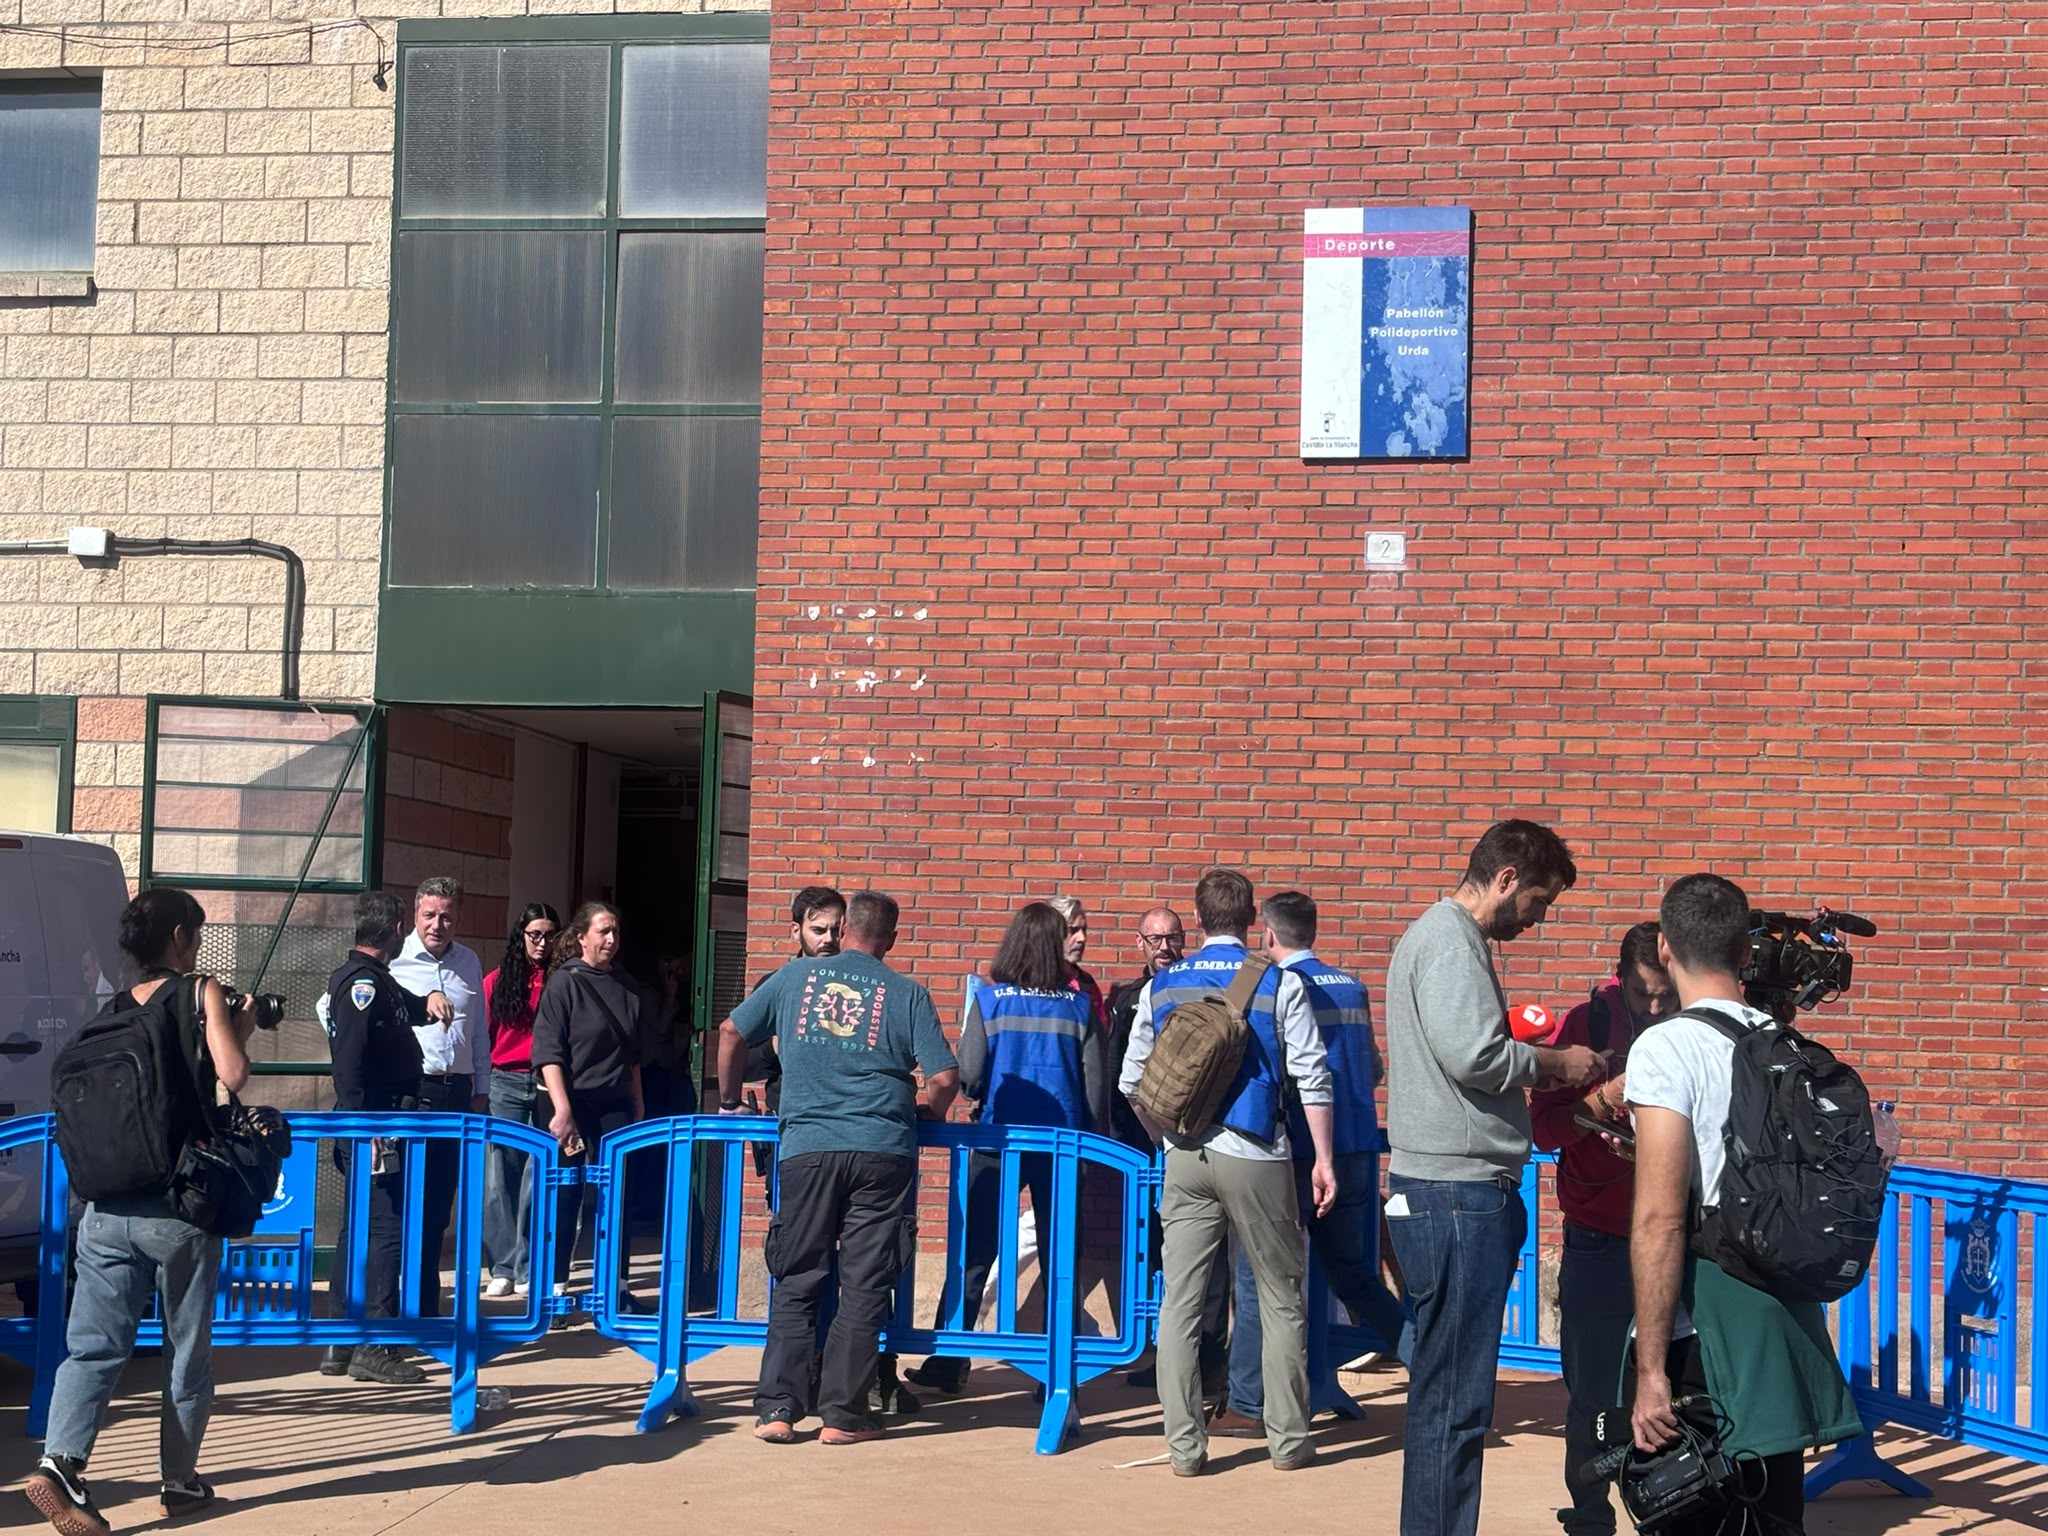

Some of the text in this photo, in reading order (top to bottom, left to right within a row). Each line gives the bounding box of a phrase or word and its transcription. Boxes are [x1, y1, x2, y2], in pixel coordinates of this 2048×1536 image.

[1325, 238, 1395, 253] Deporte
[1386, 307, 1444, 318] Pabellón
[1370, 326, 1458, 339] Polideportivo
[1398, 345, 1429, 356] Urda
[1381, 539, 1391, 558] 2
[0, 949, 21, 962] ncha
[1168, 960, 1243, 974] U.S. EMBAS
[819, 968, 879, 986] ON YOUR
[993, 986, 1018, 998] U.S.
[797, 975, 817, 1035] ESCAPE
[867, 986, 887, 1047] DOORSTEP
